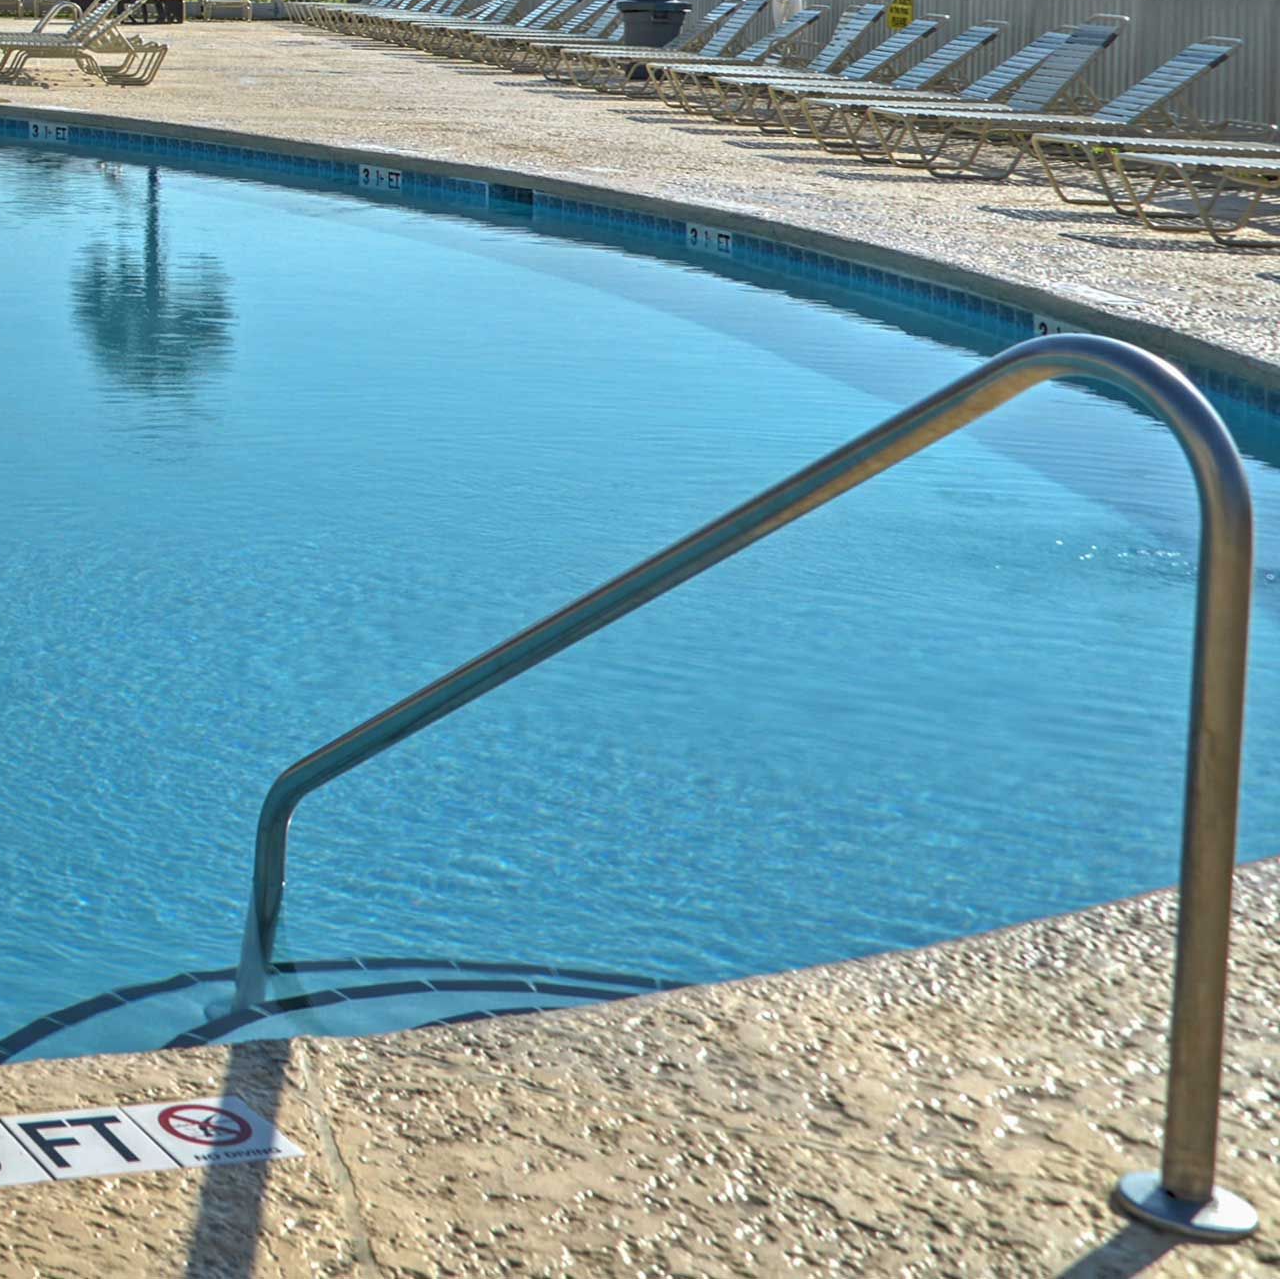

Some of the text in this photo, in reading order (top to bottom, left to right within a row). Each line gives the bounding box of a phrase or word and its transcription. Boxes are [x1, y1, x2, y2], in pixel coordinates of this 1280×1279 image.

[18, 1115, 141, 1168] FT
[193, 1147, 282, 1162] NO DIVING
